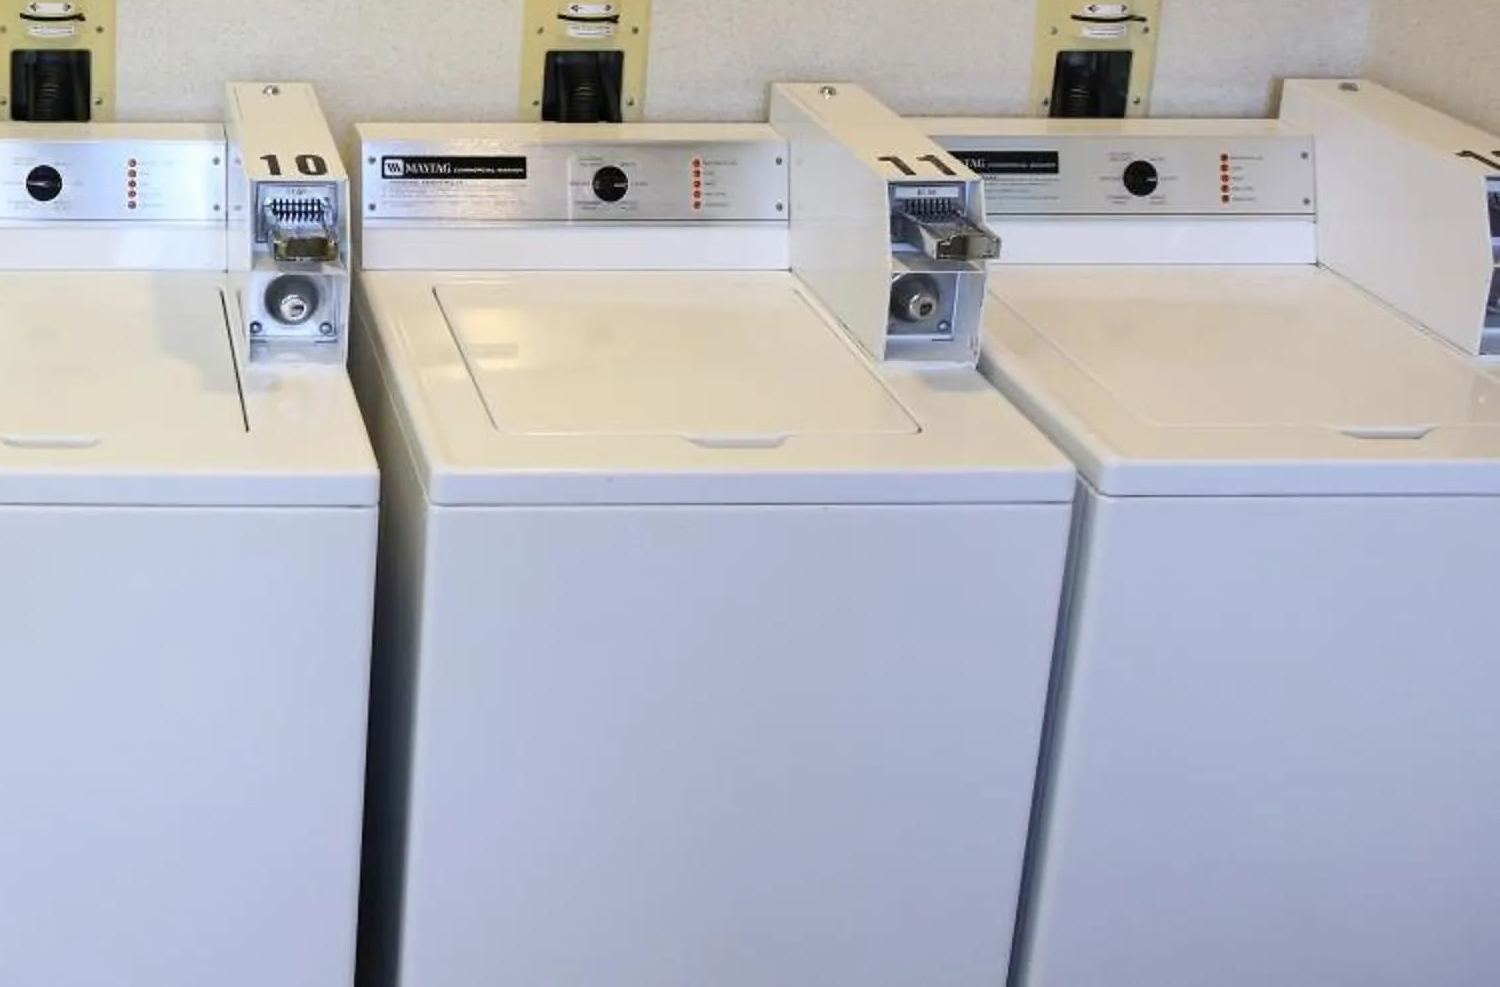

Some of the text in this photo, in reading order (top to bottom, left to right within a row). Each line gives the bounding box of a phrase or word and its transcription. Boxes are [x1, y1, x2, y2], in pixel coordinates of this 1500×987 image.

[259, 154, 328, 176] 10
[404, 161, 452, 174] MAYTAG
[876, 154, 957, 176] 11
[1454, 150, 1500, 171] 1
